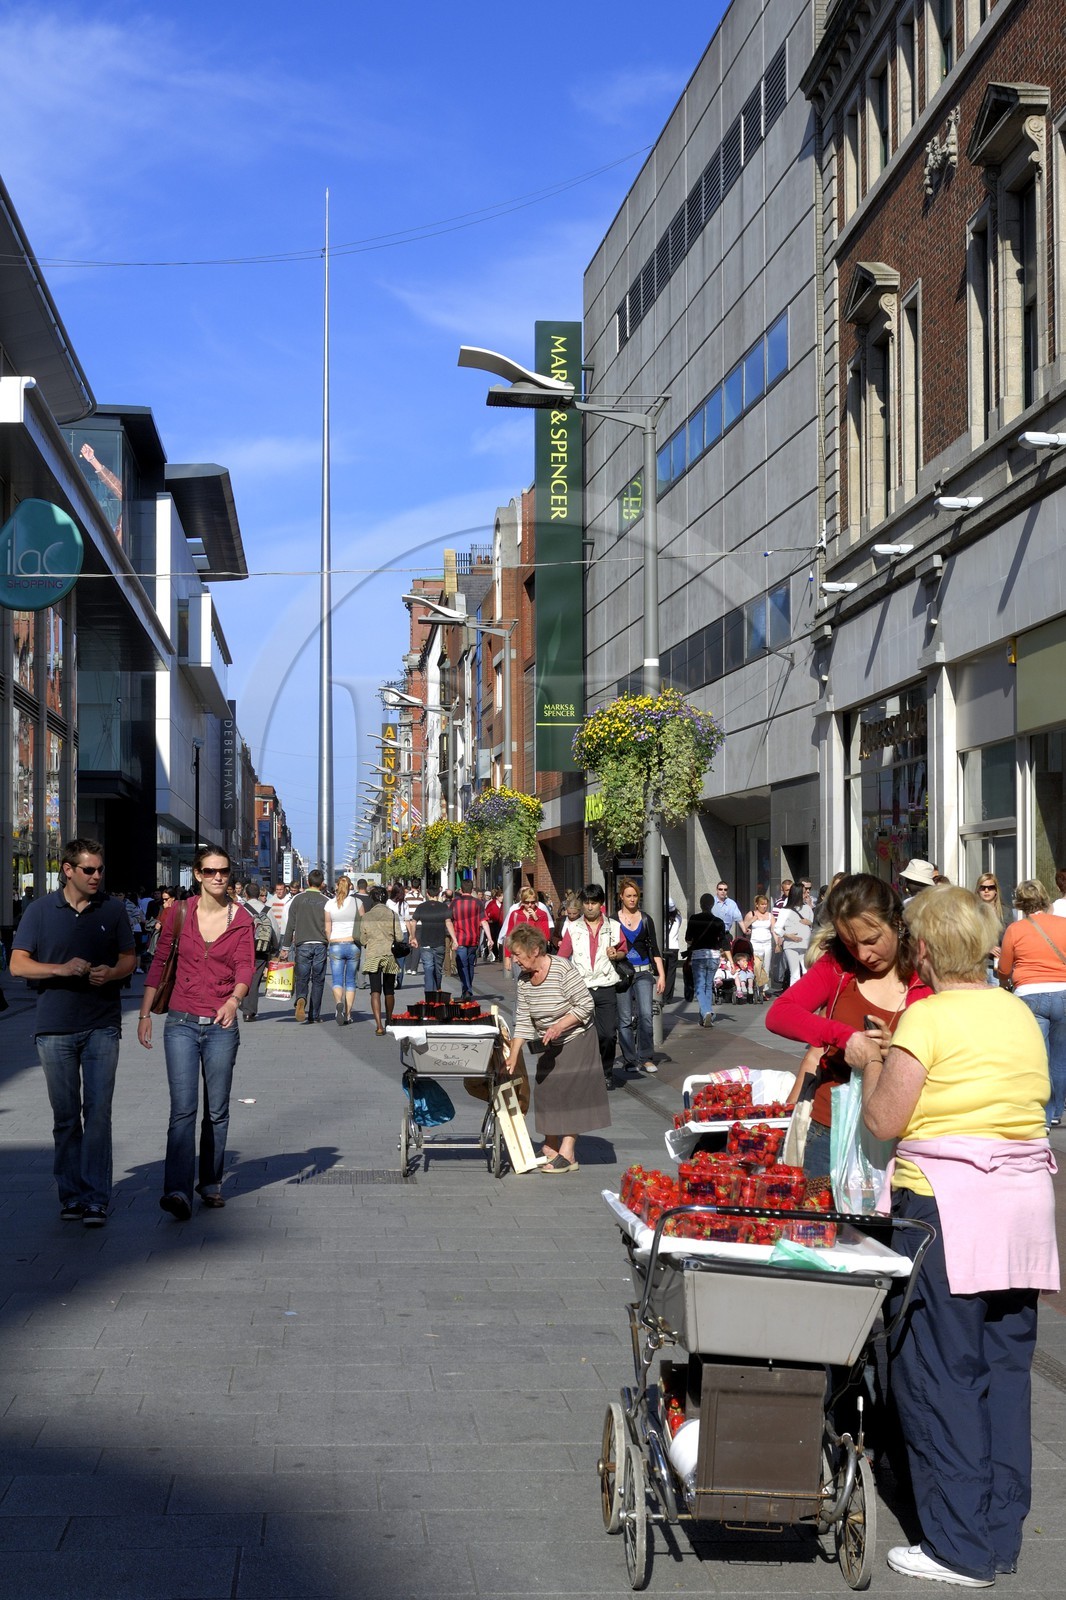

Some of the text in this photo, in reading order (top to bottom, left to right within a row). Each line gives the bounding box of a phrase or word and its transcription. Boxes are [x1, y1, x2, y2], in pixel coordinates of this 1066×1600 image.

[551, 410, 567, 425] &
[551, 428, 567, 520] SPENCER
[7, 579, 63, 589] SHOPPING
[223, 720, 233, 810] DEBENHAMS
